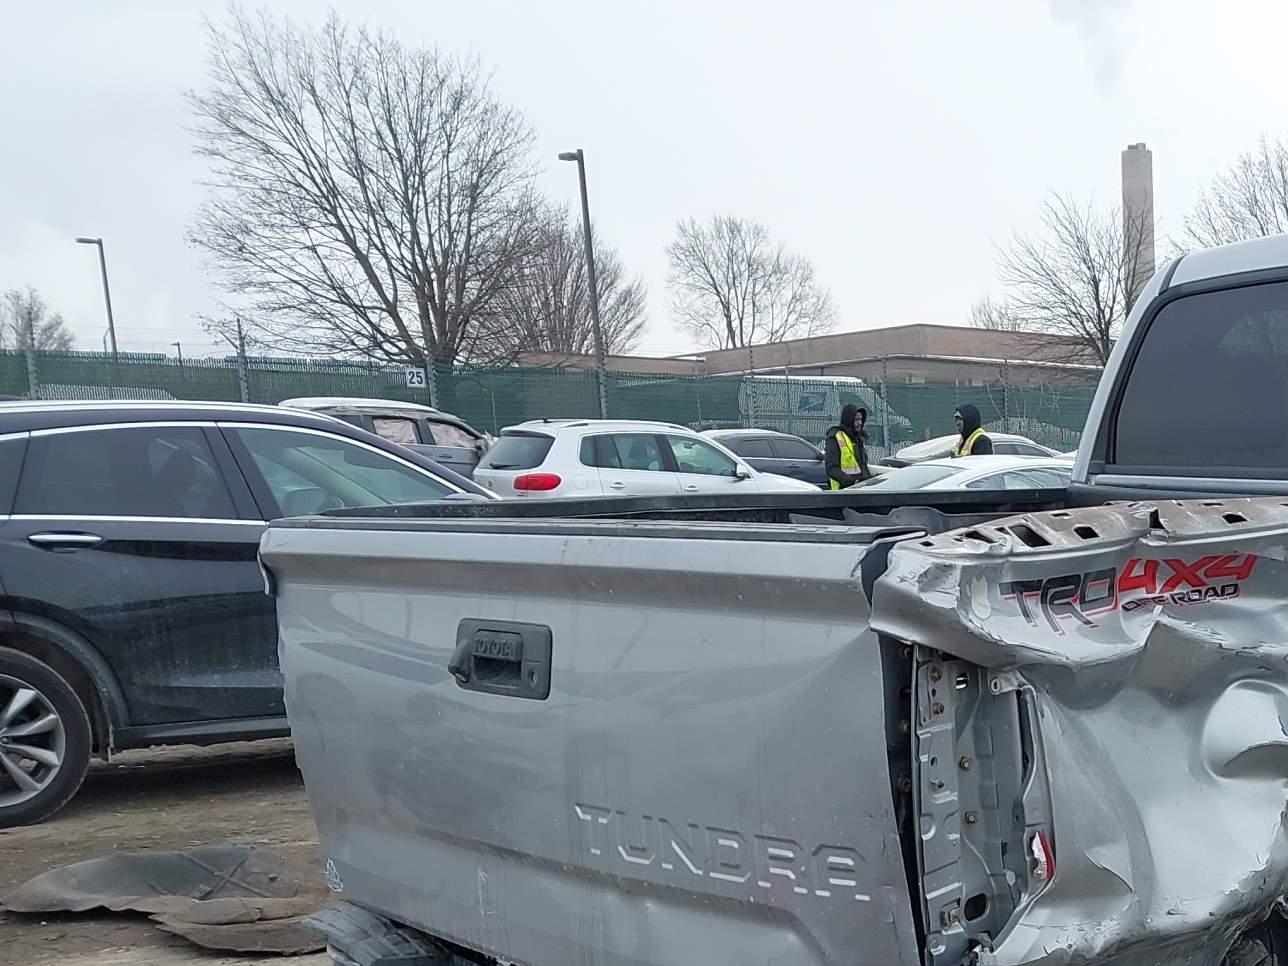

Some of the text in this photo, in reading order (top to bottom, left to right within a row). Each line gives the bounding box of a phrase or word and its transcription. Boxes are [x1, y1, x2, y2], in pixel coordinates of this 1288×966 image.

[408, 371, 424, 385] 25
[1171, 583, 1241, 606] ROAD
[474, 639, 514, 657] TOYOTA
[574, 802, 871, 901] TUNDRA
